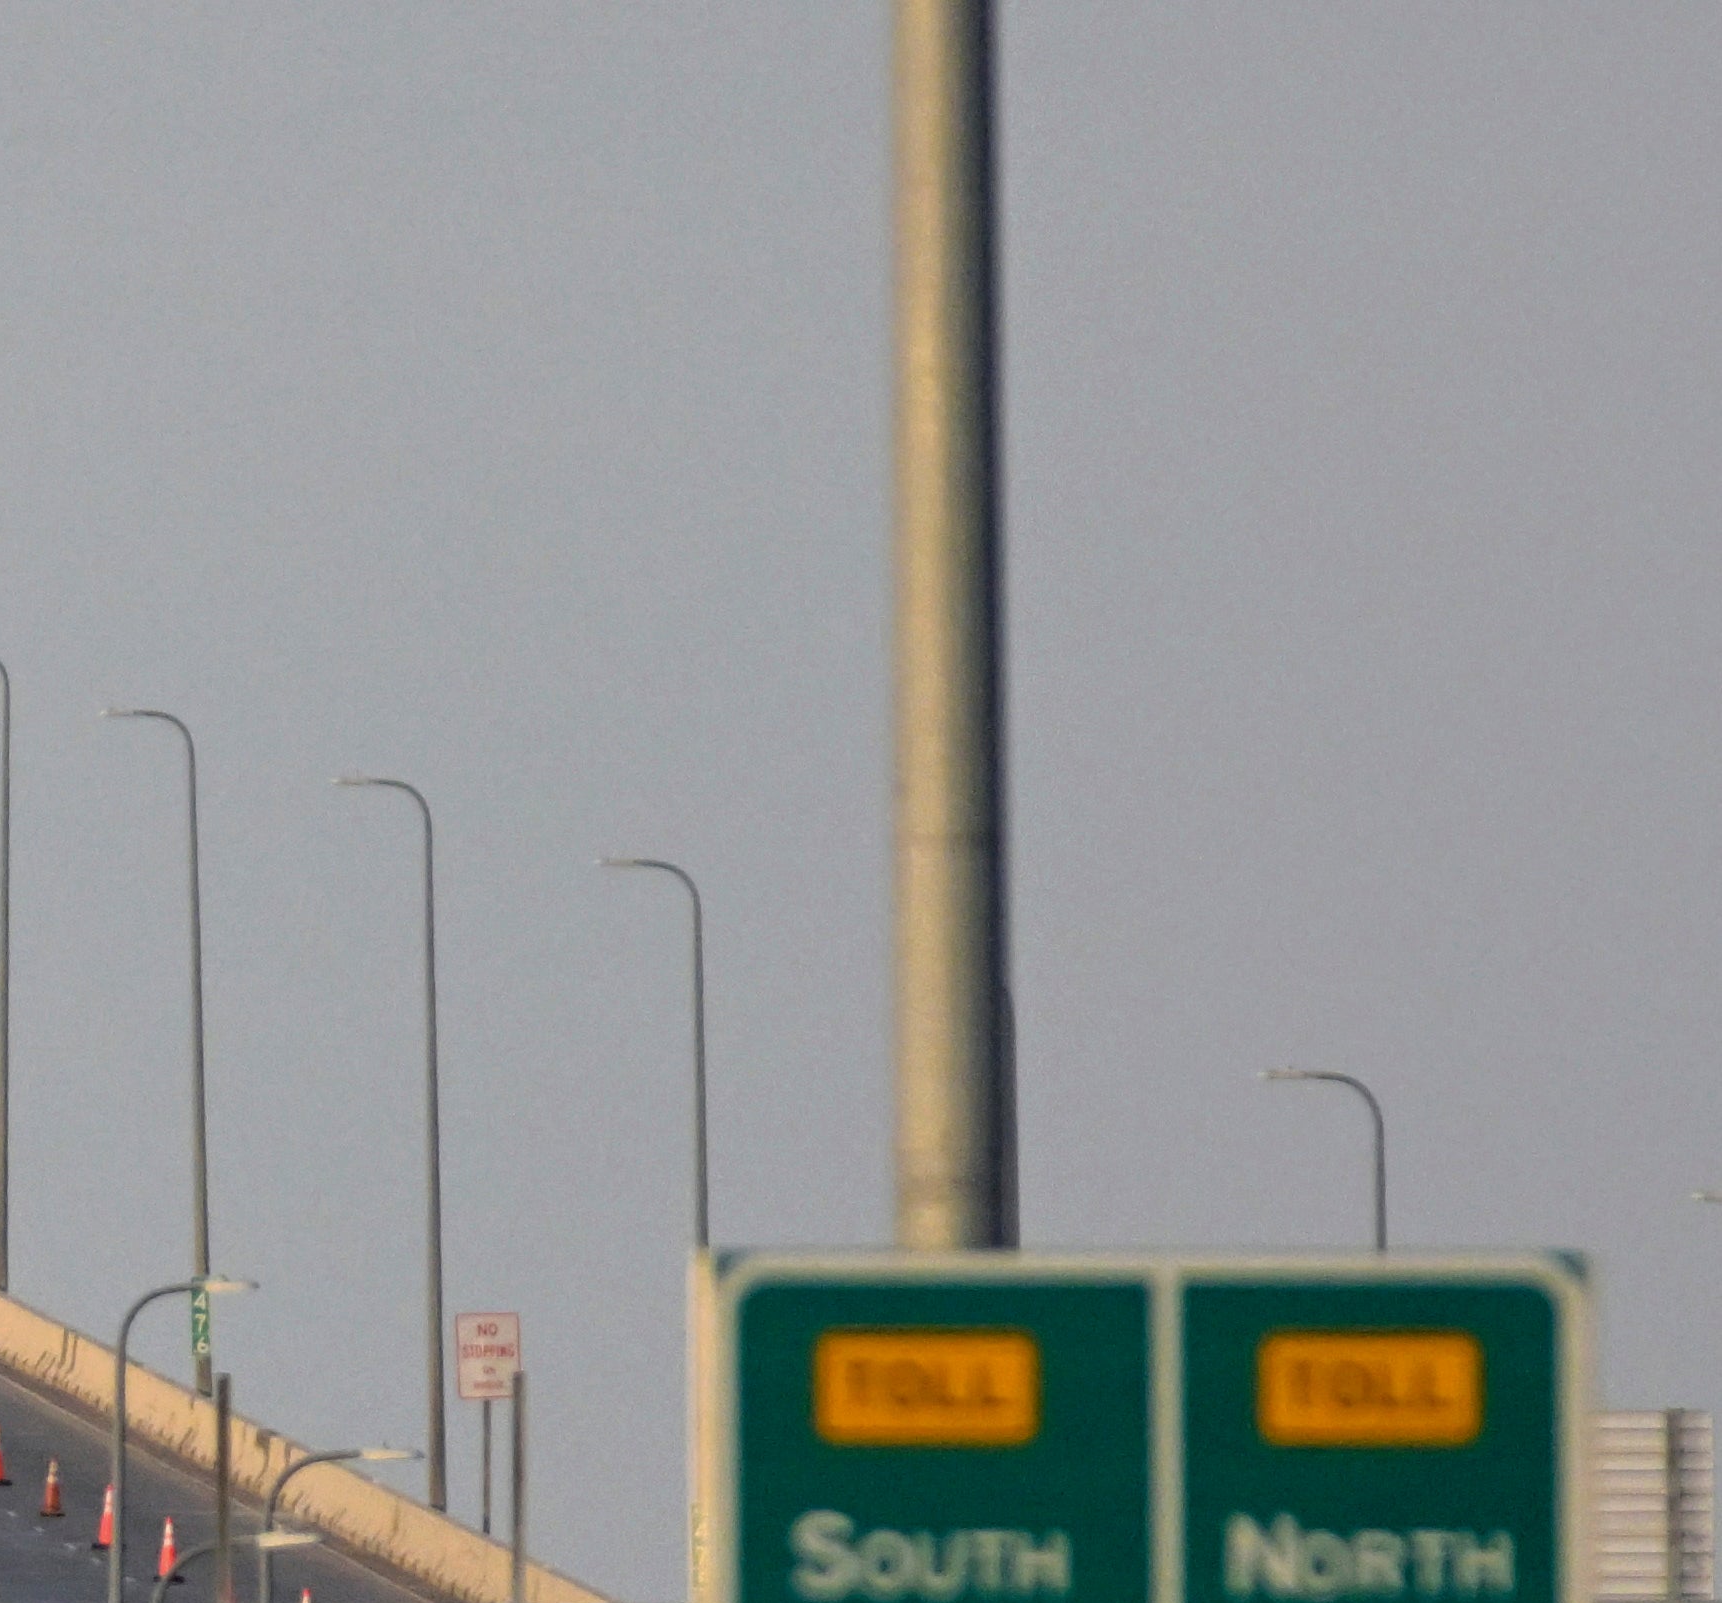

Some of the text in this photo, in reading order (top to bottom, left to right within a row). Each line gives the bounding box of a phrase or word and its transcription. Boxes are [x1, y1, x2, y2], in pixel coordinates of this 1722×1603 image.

[476, 1323, 499, 1336] NO
[462, 1344, 515, 1359] STOPPING
[844, 1358, 1014, 1412] TOLL
[1287, 1358, 1456, 1412] TOLL
